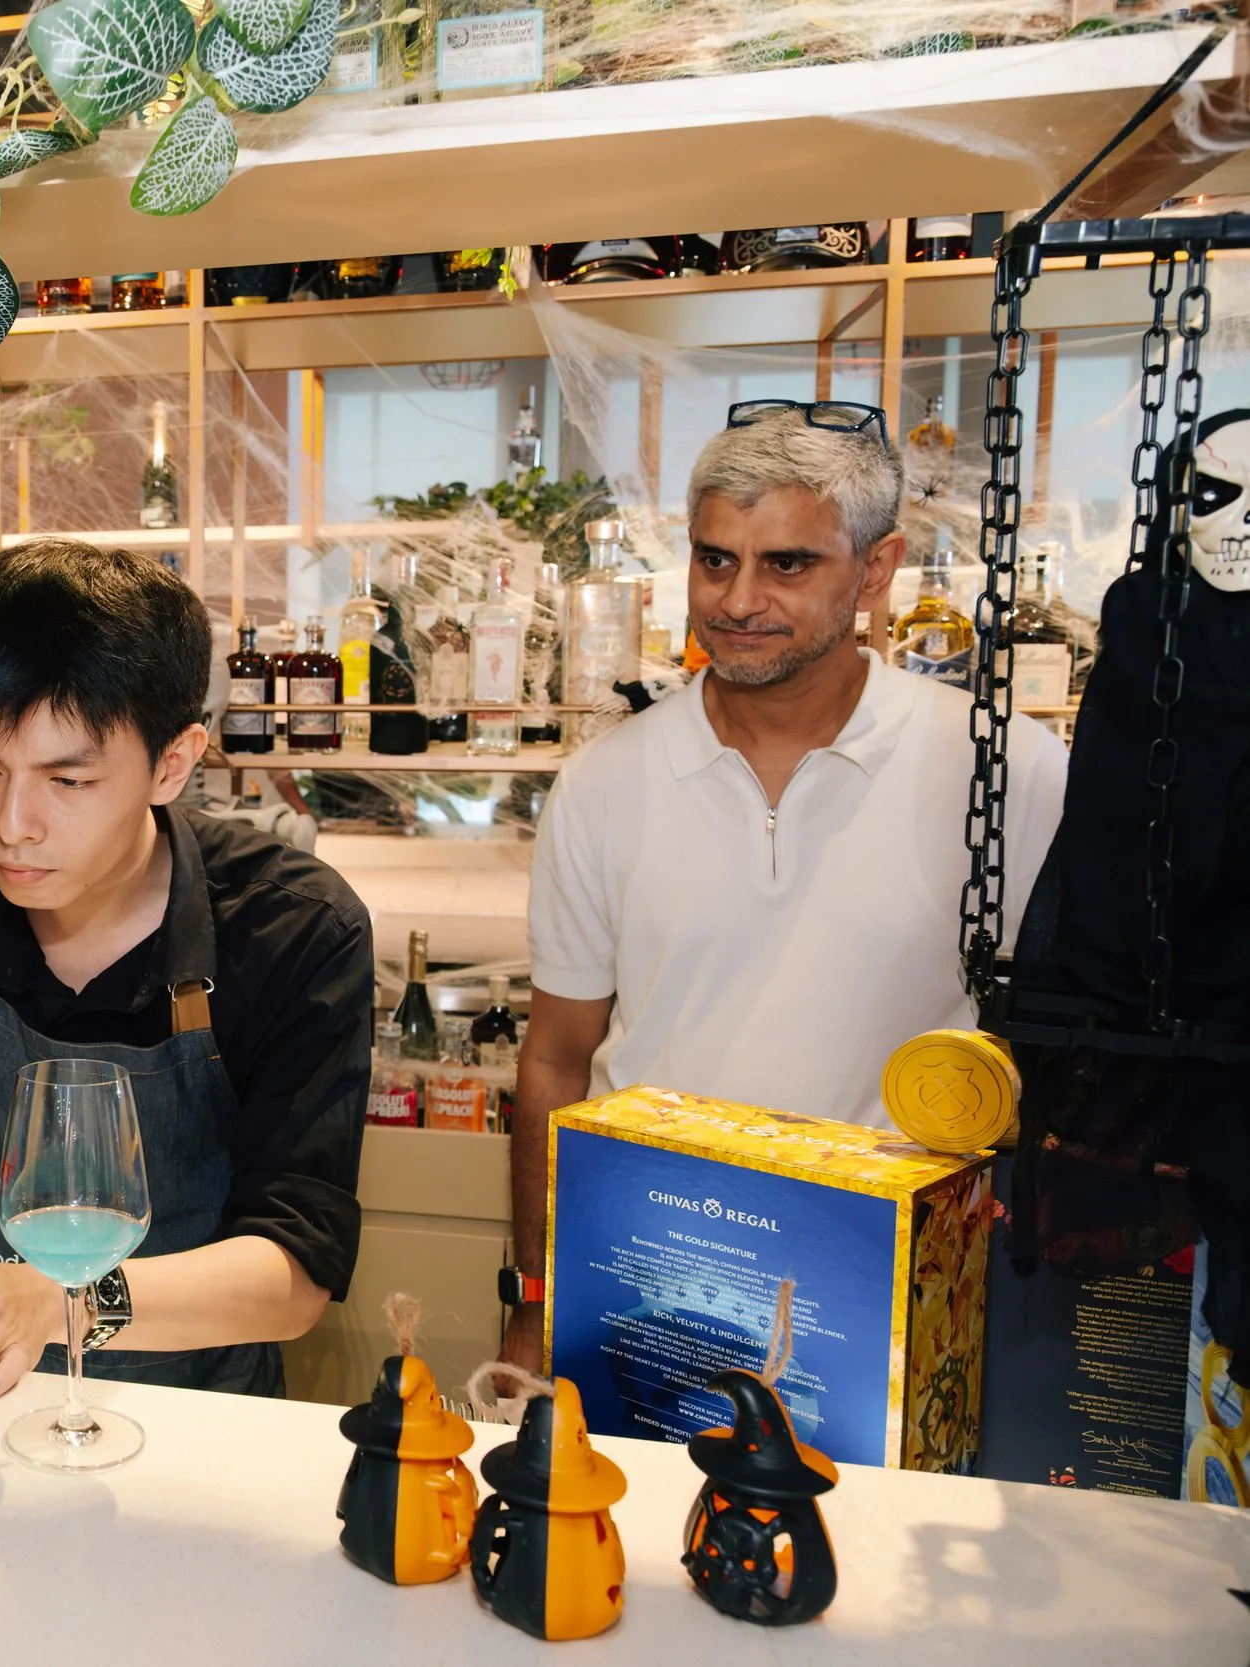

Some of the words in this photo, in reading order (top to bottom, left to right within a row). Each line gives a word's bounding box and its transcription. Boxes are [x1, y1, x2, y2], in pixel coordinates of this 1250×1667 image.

[337, 38, 369, 49] AGAVE
[500, 28, 534, 38] AGAVE
[649, 1189, 699, 1212] CHIVAS
[726, 1209, 781, 1233] REGAL
[632, 1235, 663, 1250] RENOWNED
[664, 1246, 685, 1256] ACROSS
[686, 1252, 697, 1260] THE
[698, 1255, 719, 1267] WORLD,
[721, 1261, 741, 1272] CHIVAS
[742, 1267, 759, 1277] REGAL
[668, 1230, 683, 1241] THE
[685, 1235, 709, 1248] GOLD
[710, 1241, 757, 1261] SIGNATURE
[619, 1278, 635, 1287] SANDY
[622, 1249, 633, 1257] RICH
[634, 1252, 646, 1260] AND
[647, 1256, 672, 1268] COMPLEX
[673, 1263, 689, 1272] TASTE
[698, 1270, 709, 1278] THE
[709, 1274, 730, 1284] CHIVAS
[731, 1280, 750, 1290] HOUSE
[751, 1285, 768, 1295] STYLE
[629, 1258, 648, 1269] CALLED
[650, 1264, 660, 1272] THE
[660, 1267, 675, 1277] GOLD
[749, 1293, 772, 1304] WHISKY
[791, 1305, 812, 1316] BLEND
[674, 1256, 694, 1267] ICONIC
[717, 1268, 737, 1279] WHICH
[738, 1274, 764, 1286] ELEVATES
[606, 1267, 622, 1276] FINEST
[623, 1272, 635, 1280] OAK
[635, 1275, 652, 1285] CASKS
[653, 1280, 665, 1289] AND
[793, 1322, 817, 1334] MASTER
[817, 1329, 847, 1344] BLENDER,
[618, 1263, 657, 1279] METICULOUSLY
[701, 1287, 718, 1297] AFTER
[790, 1313, 818, 1326] ATURING
[606, 1310, 616, 1318] OUR
[618, 1314, 637, 1325] MASTER
[638, 1321, 664, 1334] BLENDERS
[665, 1329, 679, 1338] HAVE
[680, 1334, 709, 1348] IDENTIFIED
[710, 1344, 725, 1353] OVER
[733, 1351, 759, 1364] FLAVOUR
[653, 1309, 675, 1323] RICH,
[676, 1316, 709, 1333] VELVETY
[719, 1329, 768, 1351] INDULGENT
[600, 1316, 628, 1330] INCLUDING
[629, 1326, 641, 1334] RICH
[643, 1330, 657, 1339] FRUIT
[658, 1335, 672, 1344] WITH
[672, 1339, 696, 1353] VANILLA,
[697, 1347, 723, 1361] POACHED
[724, 1356, 743, 1368] PEARS,
[744, 1362, 762, 1373] SWEET
[788, 1377, 828, 1396] MARMALADE,
[601, 1345, 616, 1355] RIGHT
[634, 1356, 650, 1366] HEART
[660, 1365, 672, 1373] OUR
[673, 1369, 689, 1379] LABEL
[690, 1375, 700, 1383] LIES
[620, 1337, 631, 1345] LIKE
[632, 1341, 650, 1351] VELVET
[660, 1350, 670, 1358] THE
[671, 1354, 692, 1367] PALATE,
[693, 1361, 717, 1374] LEADING
[644, 1337, 657, 1346] DARK
[659, 1342, 691, 1358] CHOCOLATE
[698, 1355, 710, 1364] JUST
[716, 1361, 730, 1370] HINT
[672, 1376, 702, 1391] FRIENDSHIP
[635, 1413, 659, 1427] BLENDED
[660, 1423, 673, 1432] AND
[674, 1428, 693, 1440] BOTTL
[679, 1400, 705, 1414] DISCOVER
[706, 1410, 722, 1420] MORE
